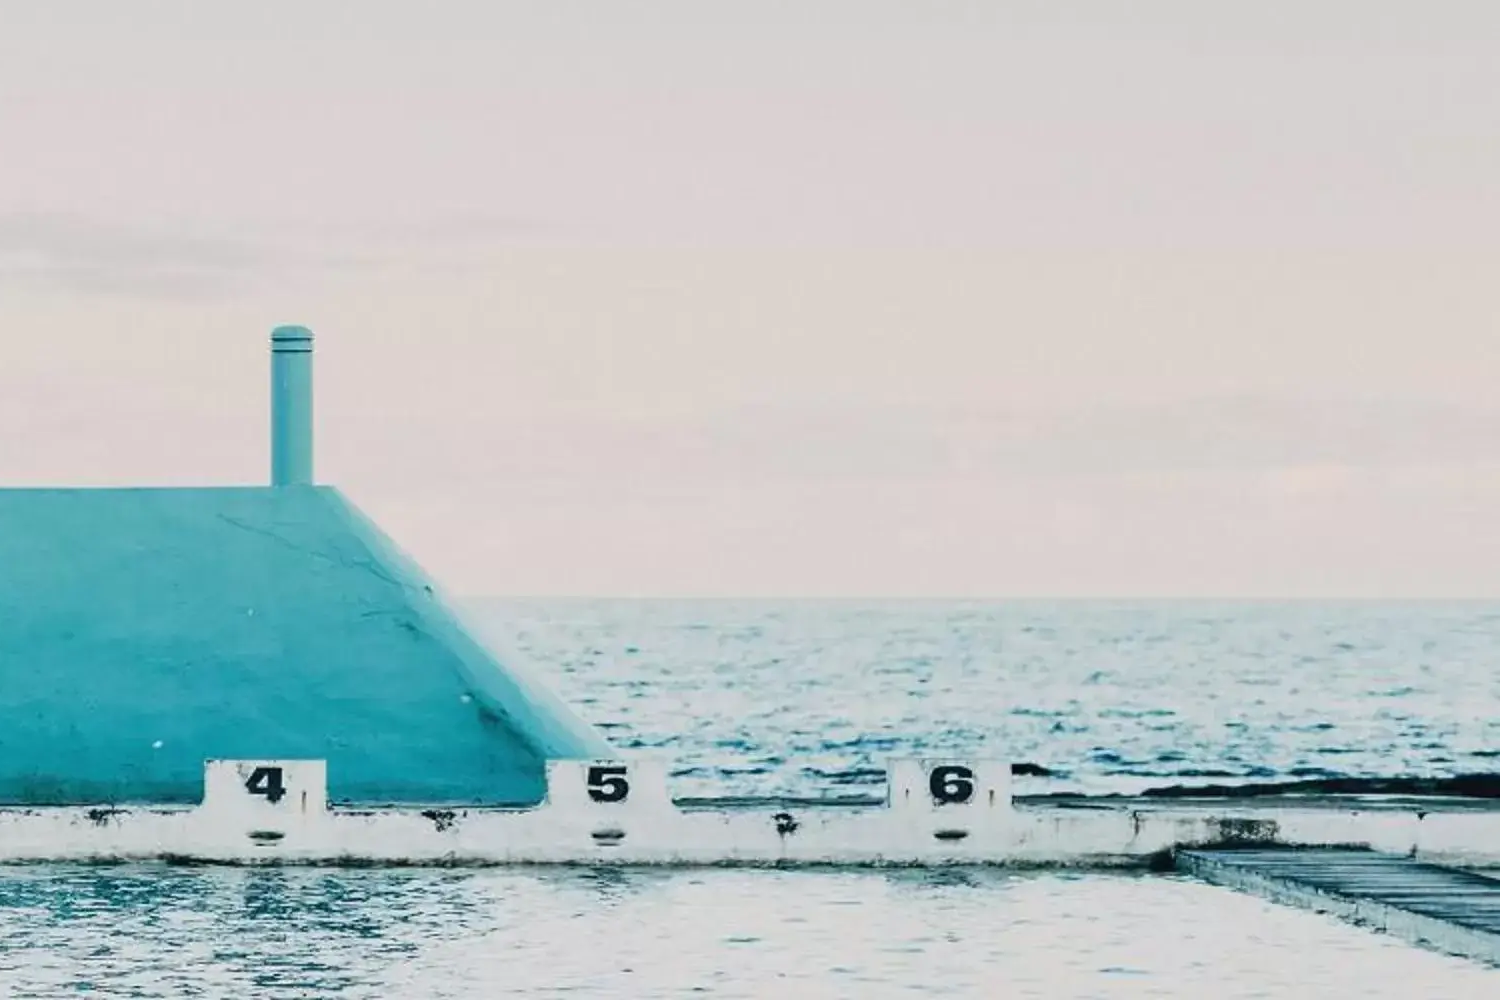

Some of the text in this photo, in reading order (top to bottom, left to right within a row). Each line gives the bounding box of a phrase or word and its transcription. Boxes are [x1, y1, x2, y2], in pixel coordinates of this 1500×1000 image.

[245, 767, 286, 803] 4
[587, 766, 629, 803] 5
[929, 765, 974, 804] 6
